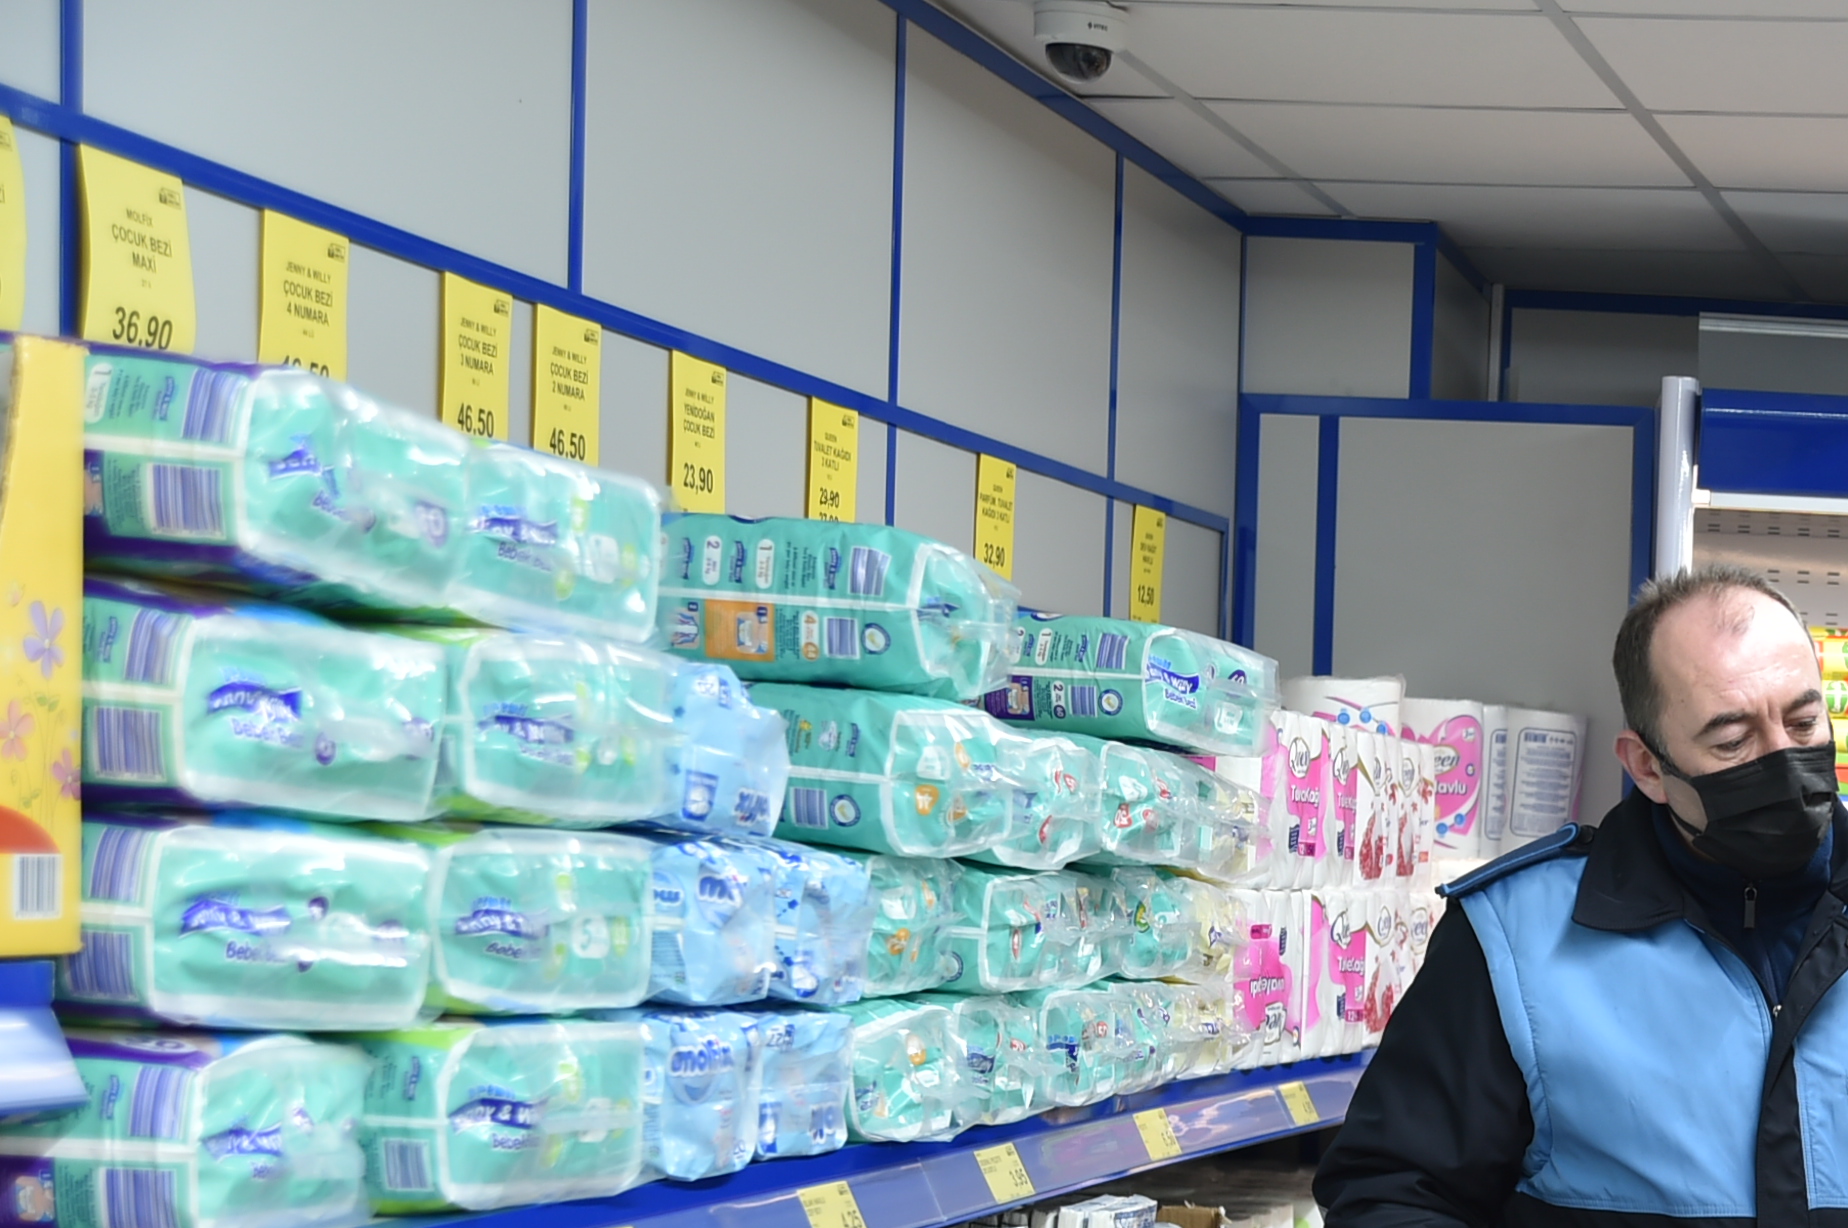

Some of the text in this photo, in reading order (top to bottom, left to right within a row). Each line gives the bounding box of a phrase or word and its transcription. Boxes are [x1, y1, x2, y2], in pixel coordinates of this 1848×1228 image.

[111, 224, 173, 258] ÇOCUK BEZİ
[312, 269, 331, 284] WILLY
[283, 279, 333, 307] ÇOCUK BEZİ
[294, 303, 330, 327] NUMARA
[458, 335, 498, 359] ÇOCUK BEZİ
[465, 354, 494, 376] NUMARA
[549, 362, 589, 385] ÇOCUK BEZİ
[556, 382, 586, 401] NUMARA
[683, 418, 701, 435] ÇOCUK
[683, 463, 714, 495] 23,90
